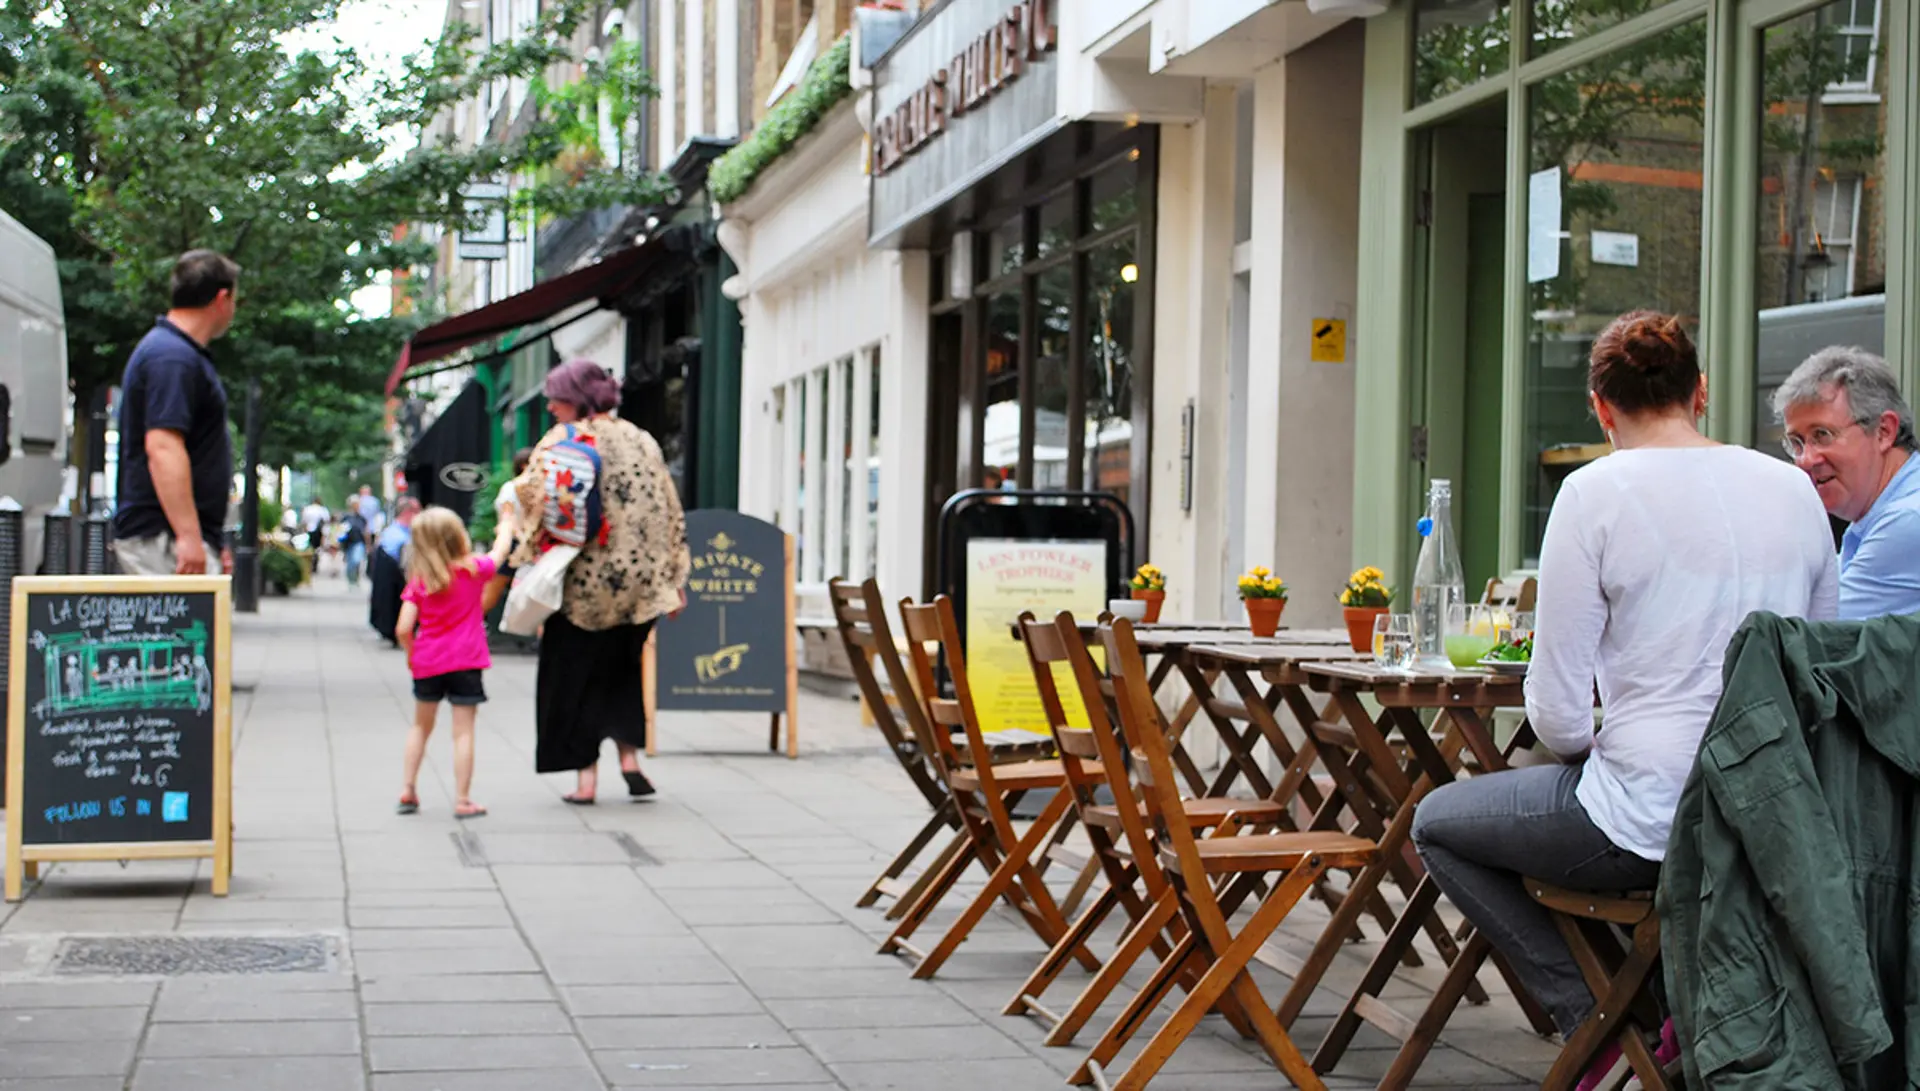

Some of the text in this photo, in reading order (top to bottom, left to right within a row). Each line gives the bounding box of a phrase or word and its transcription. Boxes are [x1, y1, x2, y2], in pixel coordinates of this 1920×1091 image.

[692, 551, 765, 578] RIVATE
[689, 579, 758, 594] WHITE
[47, 598, 73, 626] LA
[44, 799, 101, 824] FOLLOW
[108, 795, 128, 817] US
